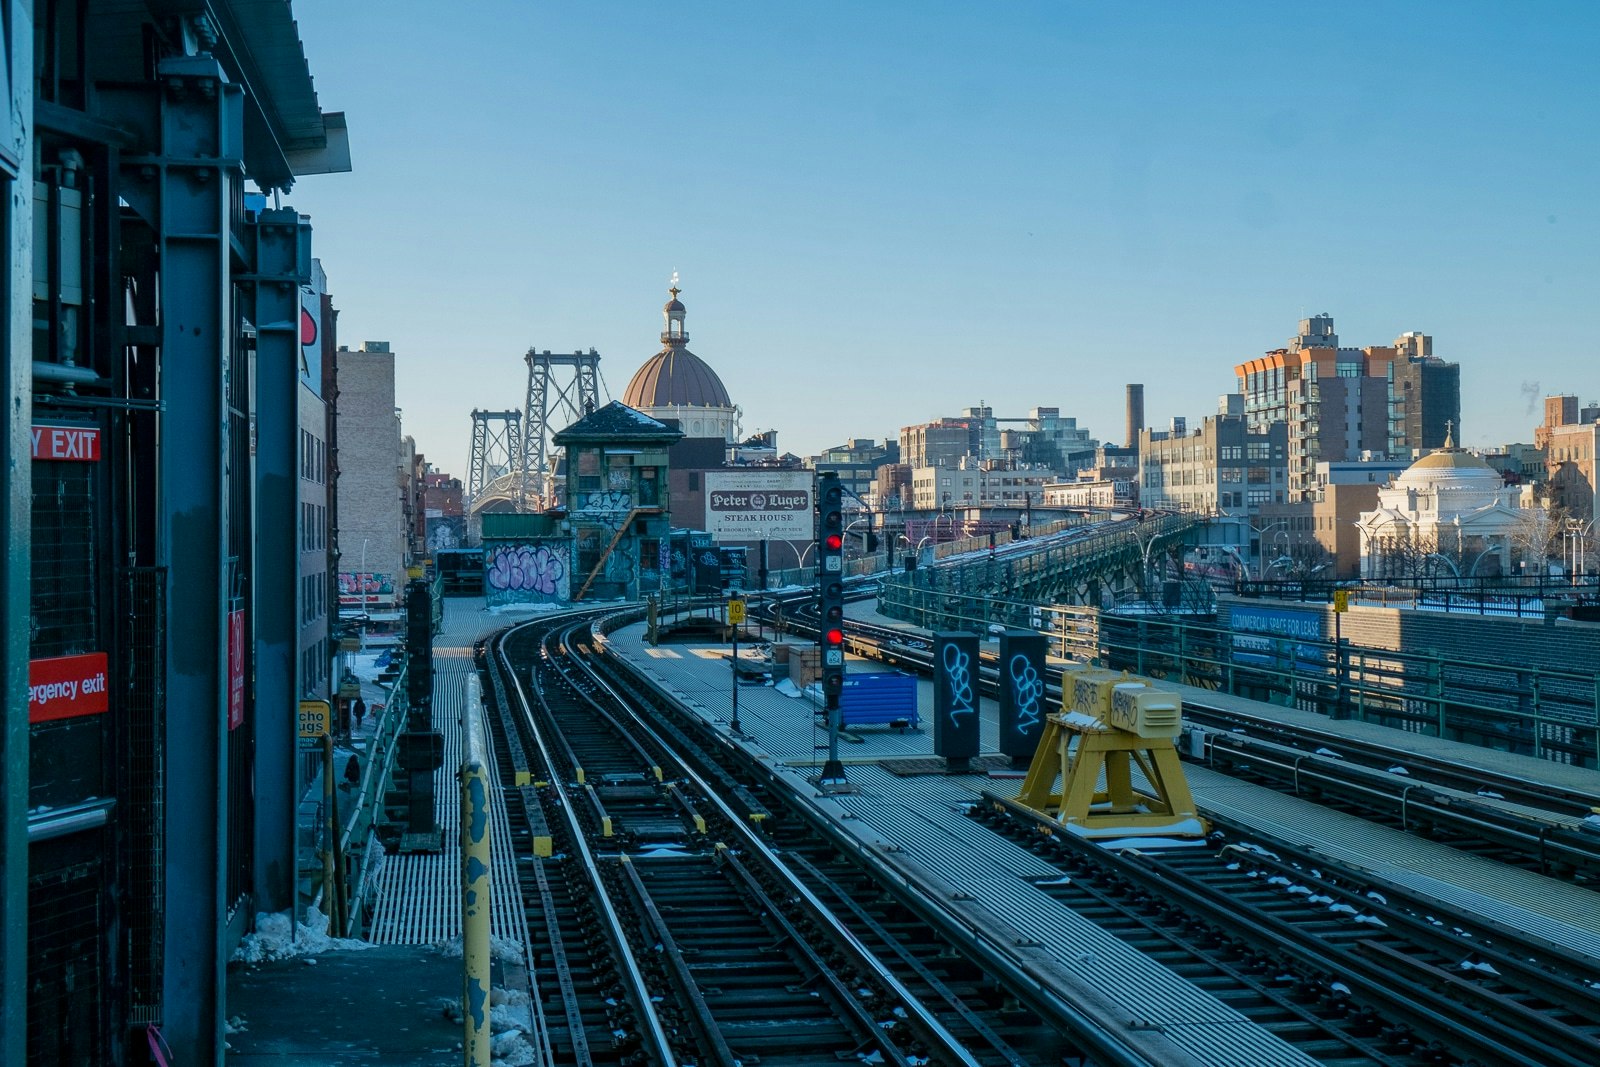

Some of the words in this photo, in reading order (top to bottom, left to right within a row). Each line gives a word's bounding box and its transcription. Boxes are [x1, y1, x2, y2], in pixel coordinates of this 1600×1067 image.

[52, 430, 96, 459] EXIT
[1114, 482, 1129, 492] LOVE
[712, 494, 748, 507] Peter
[769, 494, 807, 510] Luger
[724, 514, 758, 522] STEAK
[731, 604, 741, 614] 10
[1232, 614, 1268, 630] COMMERCIAL
[1269, 617, 1287, 632] SPACE
[1287, 618, 1300, 634] FOR
[1300, 620, 1319, 637] LEASE
[29, 681, 78, 704] ergency
[82, 672, 105, 694] exit
[299, 711, 324, 721] cho
